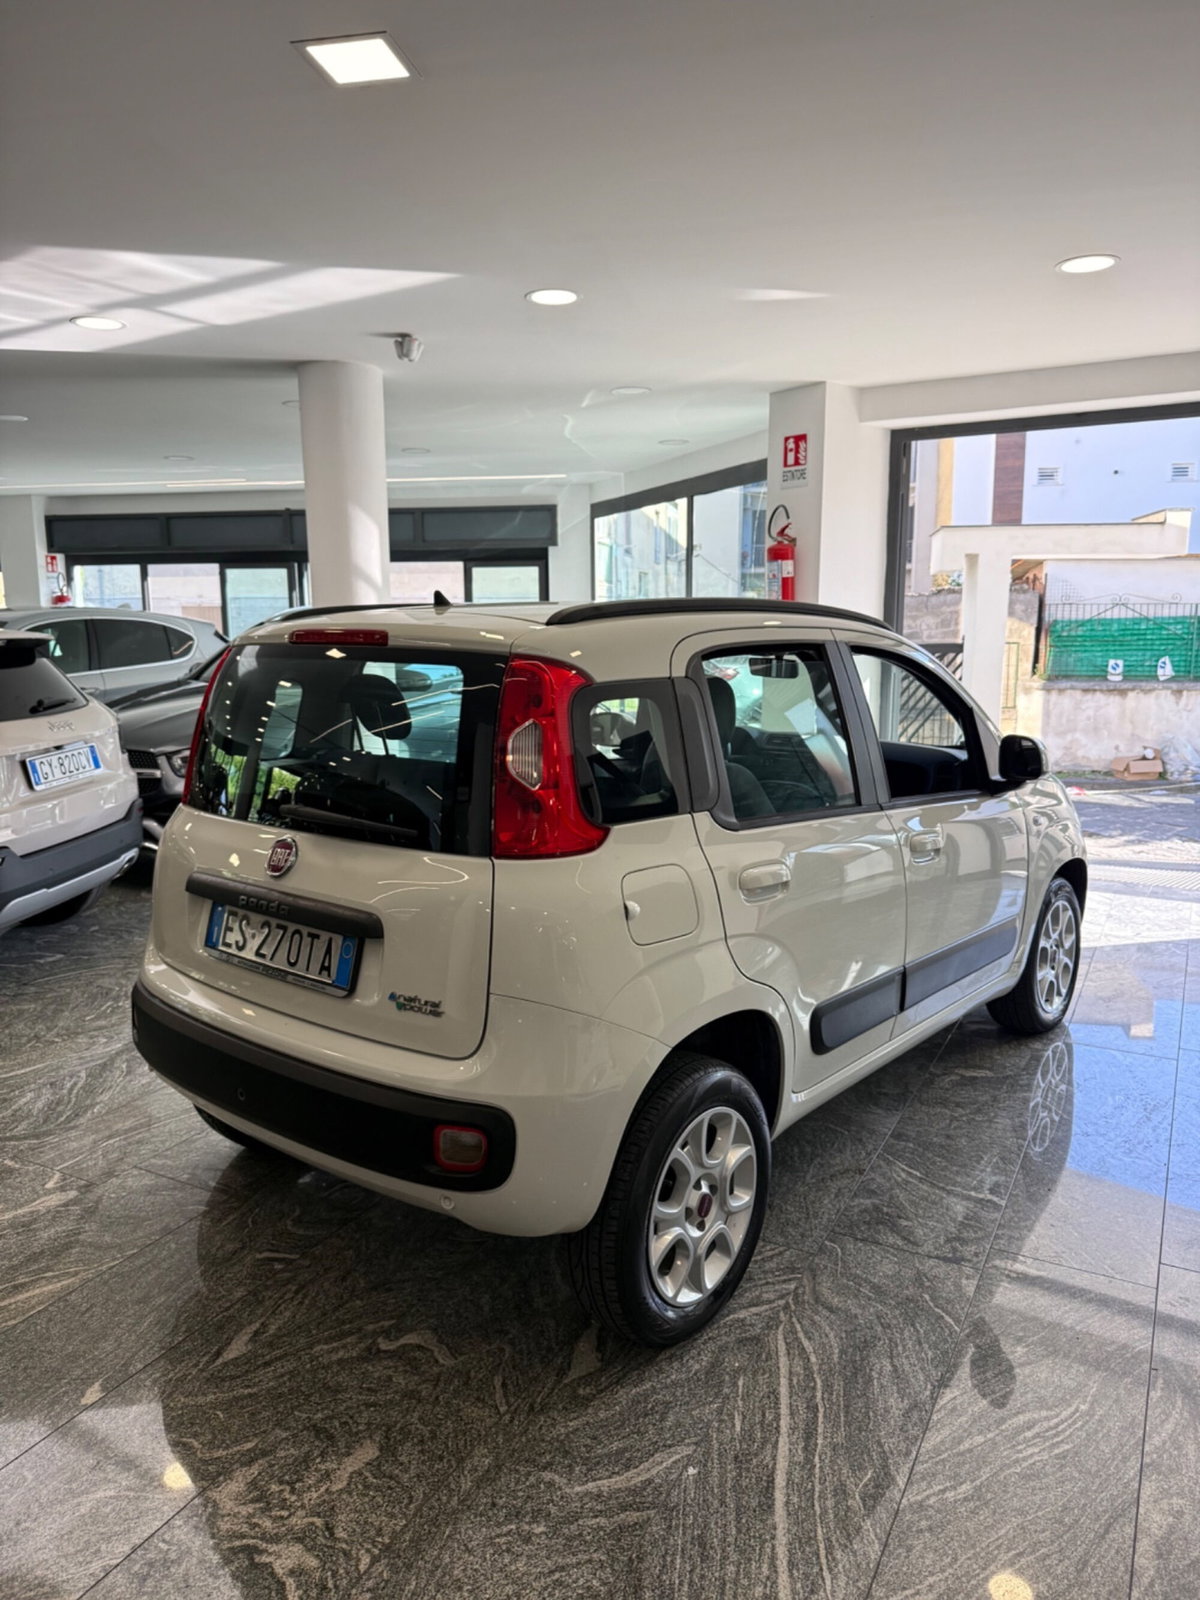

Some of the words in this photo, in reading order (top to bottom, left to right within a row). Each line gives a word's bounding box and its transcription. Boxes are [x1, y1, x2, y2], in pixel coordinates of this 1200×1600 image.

[782, 467, 807, 483] ESTINTORE
[238, 895, 289, 915] panda
[398, 993, 442, 1008] natural
[403, 1003, 445, 1017] power
